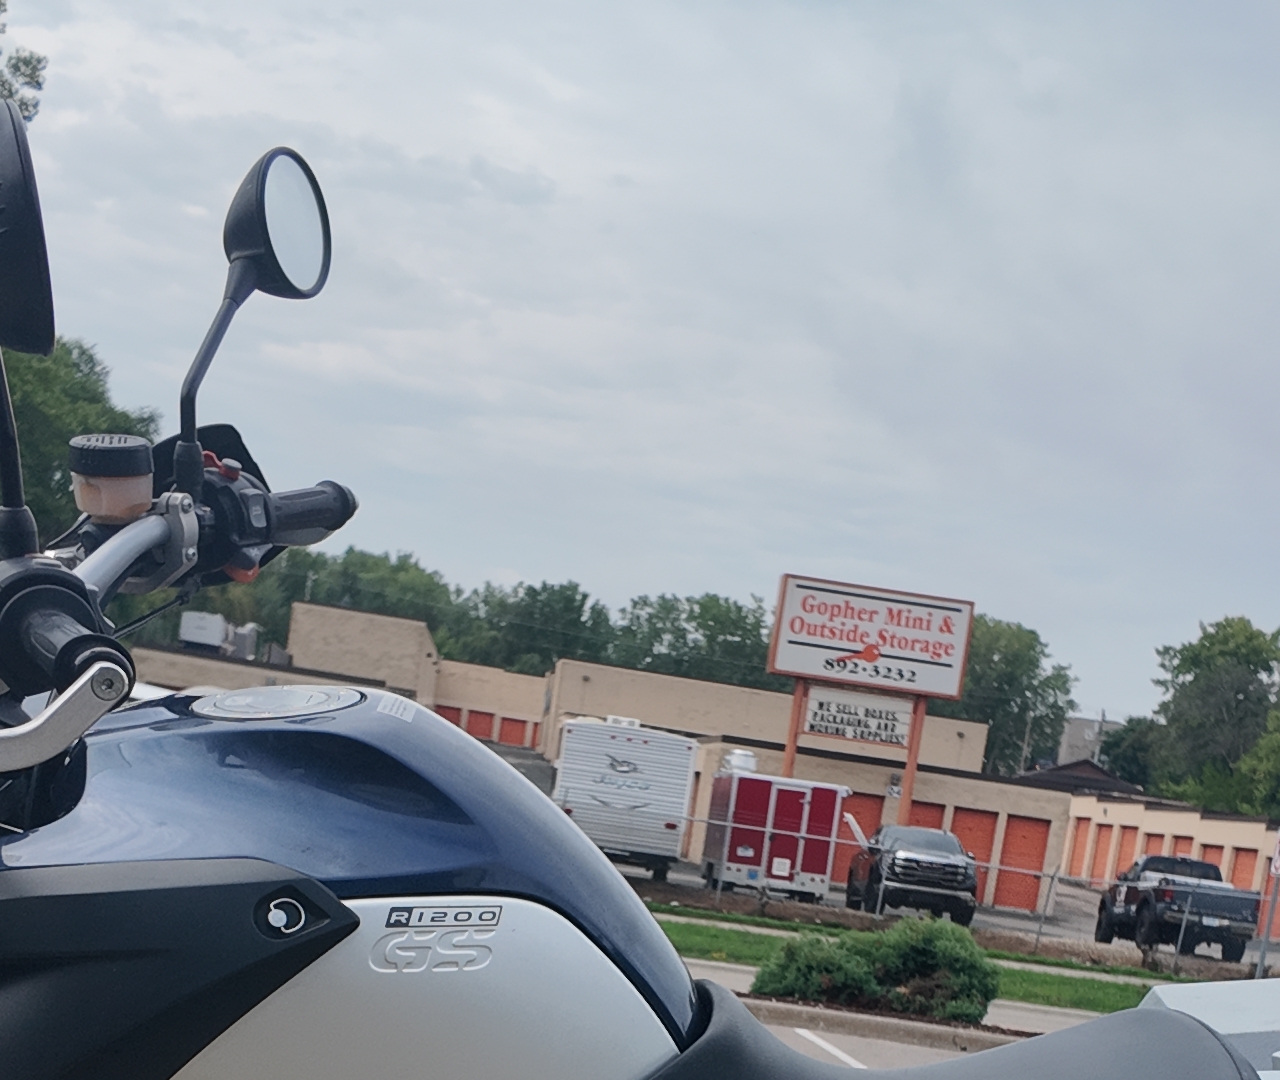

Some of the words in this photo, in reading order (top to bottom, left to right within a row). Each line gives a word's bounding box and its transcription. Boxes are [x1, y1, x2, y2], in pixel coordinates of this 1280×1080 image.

[801, 594, 879, 624] Gopher
[884, 606, 932, 632] Mini
[938, 615, 956, 636] &
[789, 615, 870, 644] Outside
[876, 628, 956, 661] Storage
[818, 701, 832, 713] WE
[836, 703, 859, 717] SELL
[369, 930, 496, 973] GS
